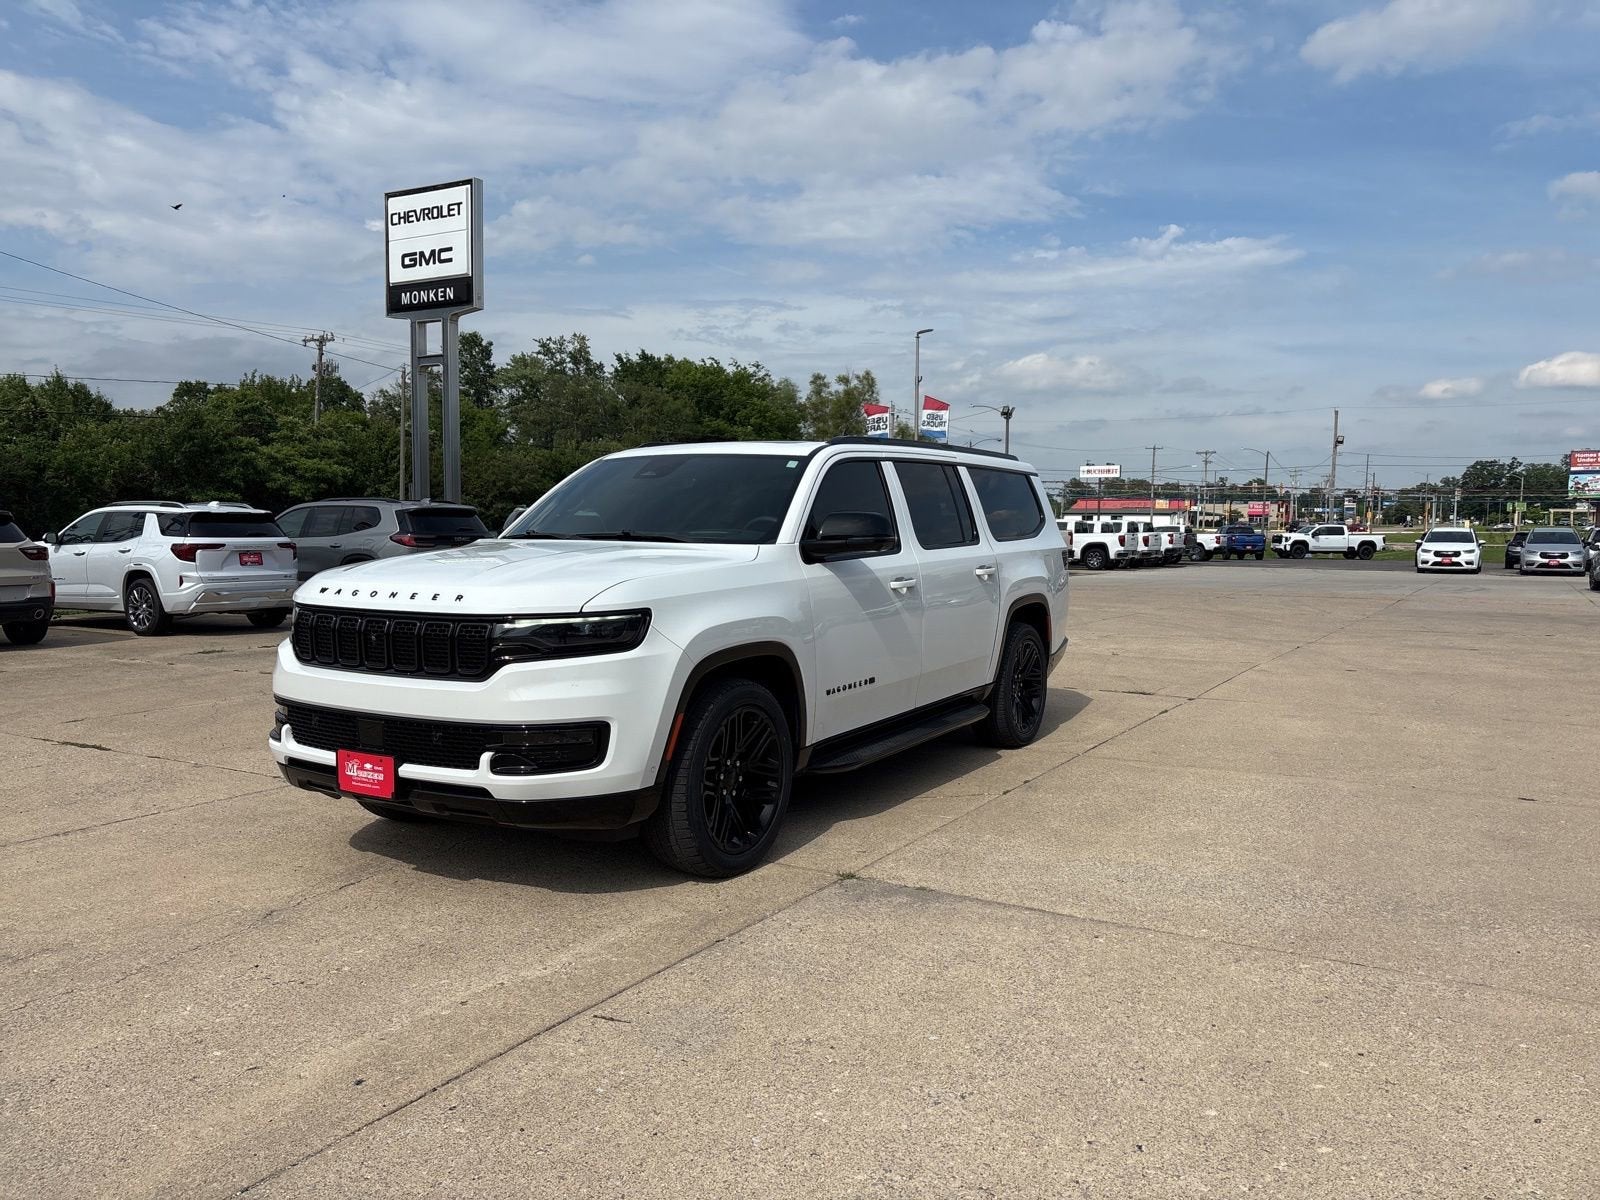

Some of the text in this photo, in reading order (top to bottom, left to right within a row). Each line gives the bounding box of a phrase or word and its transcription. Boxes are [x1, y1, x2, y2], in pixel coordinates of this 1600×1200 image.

[390, 202, 463, 226] CHEVROLET
[401, 247, 453, 269] GMC
[401, 287, 454, 305] MONKEN
[319, 587, 464, 602] WAGONEER
[826, 679, 869, 696] WAGONEER
